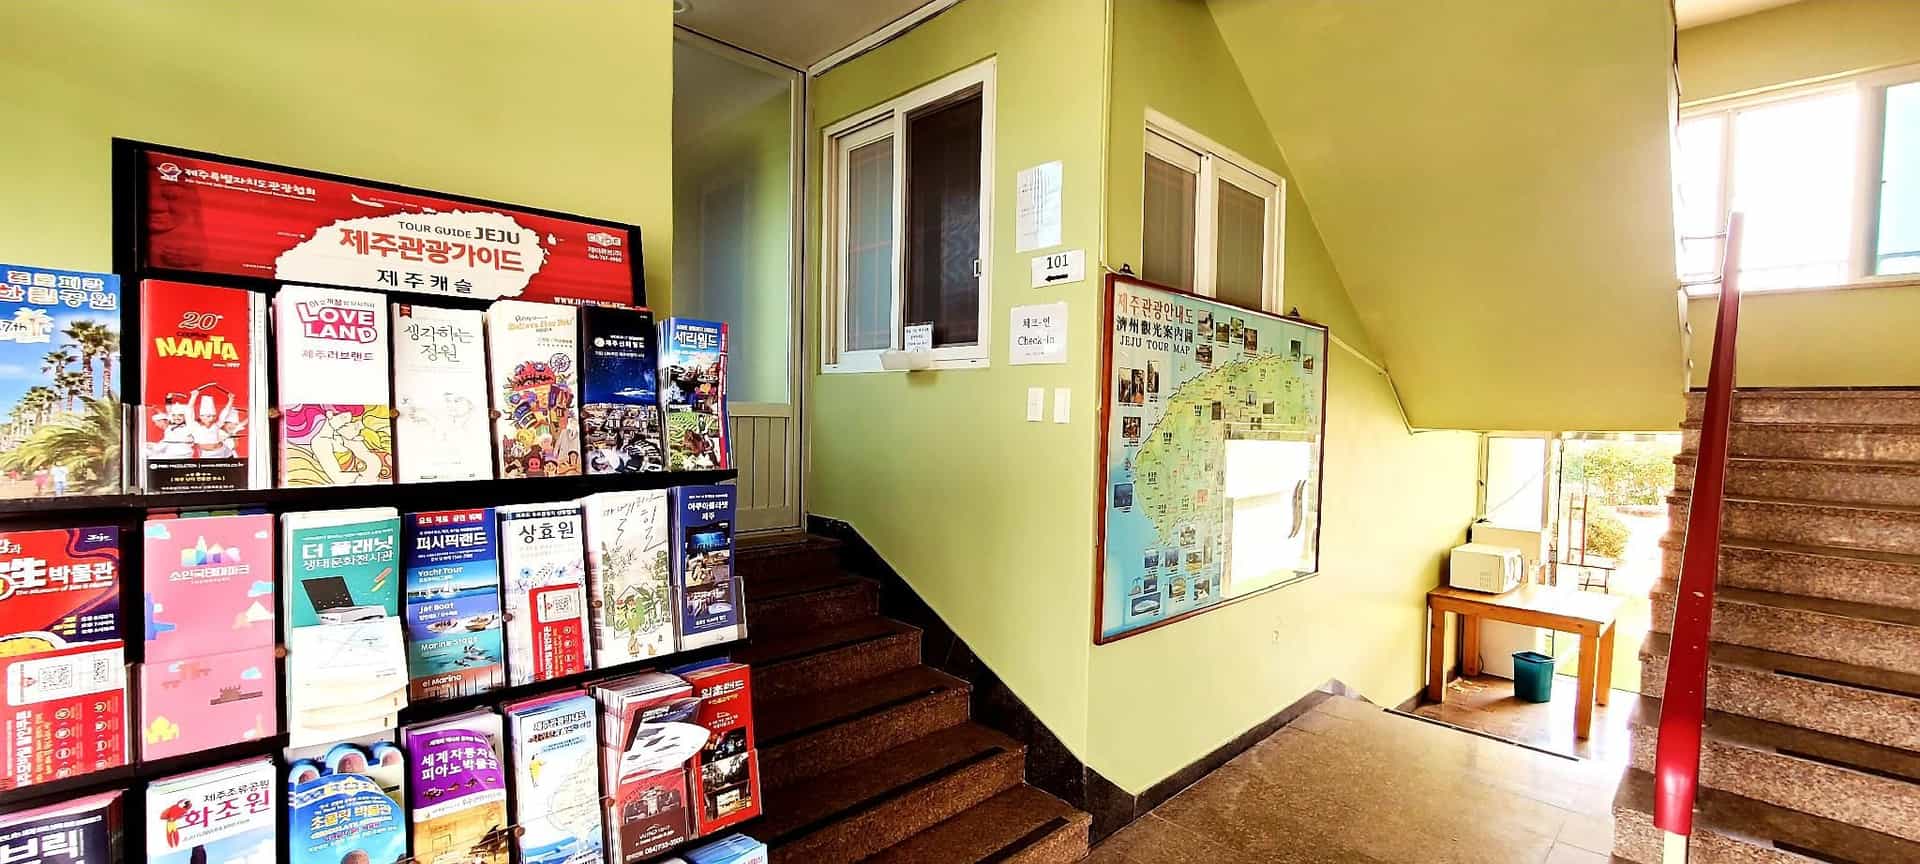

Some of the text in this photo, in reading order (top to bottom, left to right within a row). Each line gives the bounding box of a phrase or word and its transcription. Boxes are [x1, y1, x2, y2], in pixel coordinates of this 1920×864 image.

[398, 220, 520, 245] TOUR GUIDE JEJU
[340, 228, 525, 272] 제주관광가이드
[1046, 254, 1069, 270] 101
[296, 302, 374, 327] LOVE
[1118, 292, 1194, 325] 제주관광안내도
[304, 322, 377, 344] LAND
[403, 323, 475, 343] 생각하는
[673, 331, 718, 349] 세리월드
[155, 336, 240, 361] NANTA
[420, 343, 460, 363] 정원
[1120, 335, 1191, 355] JEJU TOUR MAP
[701, 511, 716, 521] 제주
[416, 531, 488, 550] 퍼시픽랜드
[518, 520, 575, 544] 상효원
[302, 535, 394, 560] 더 플래닛
[303, 549, 394, 571] 생태문화전시관
[49, 561, 115, 585] 박물관
[168, 564, 251, 582] 소인국테마파크
[418, 566, 464, 577] Yacht Tour
[419, 602, 454, 614] Jet Boat
[421, 641, 453, 651] Marine
[431, 674, 462, 686] Marino
[701, 679, 745, 700] 일출랜드
[421, 760, 498, 781] 피아노박물관
[203, 779, 270, 802] 제주조류공원
[176, 789, 271, 830] 화조원
